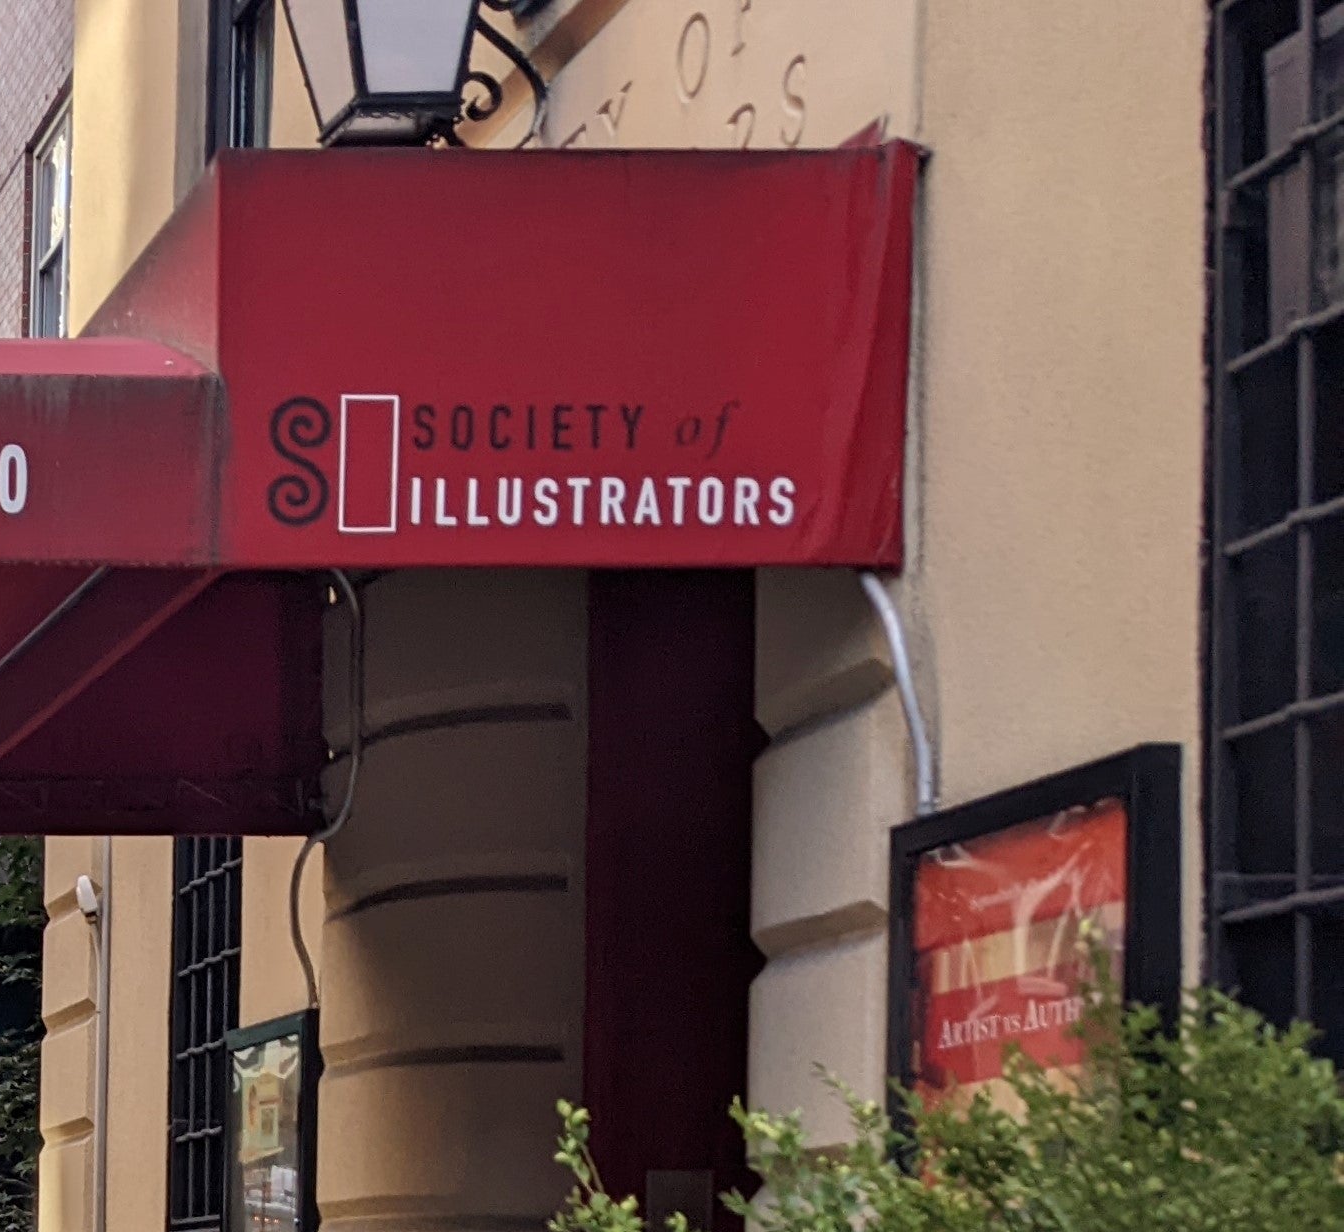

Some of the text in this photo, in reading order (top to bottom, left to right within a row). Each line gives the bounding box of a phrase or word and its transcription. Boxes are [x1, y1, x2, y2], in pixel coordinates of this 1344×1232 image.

[413, 402, 740, 460] SOCIETY of
[409, 476, 796, 527] ILLUSTRATORS
